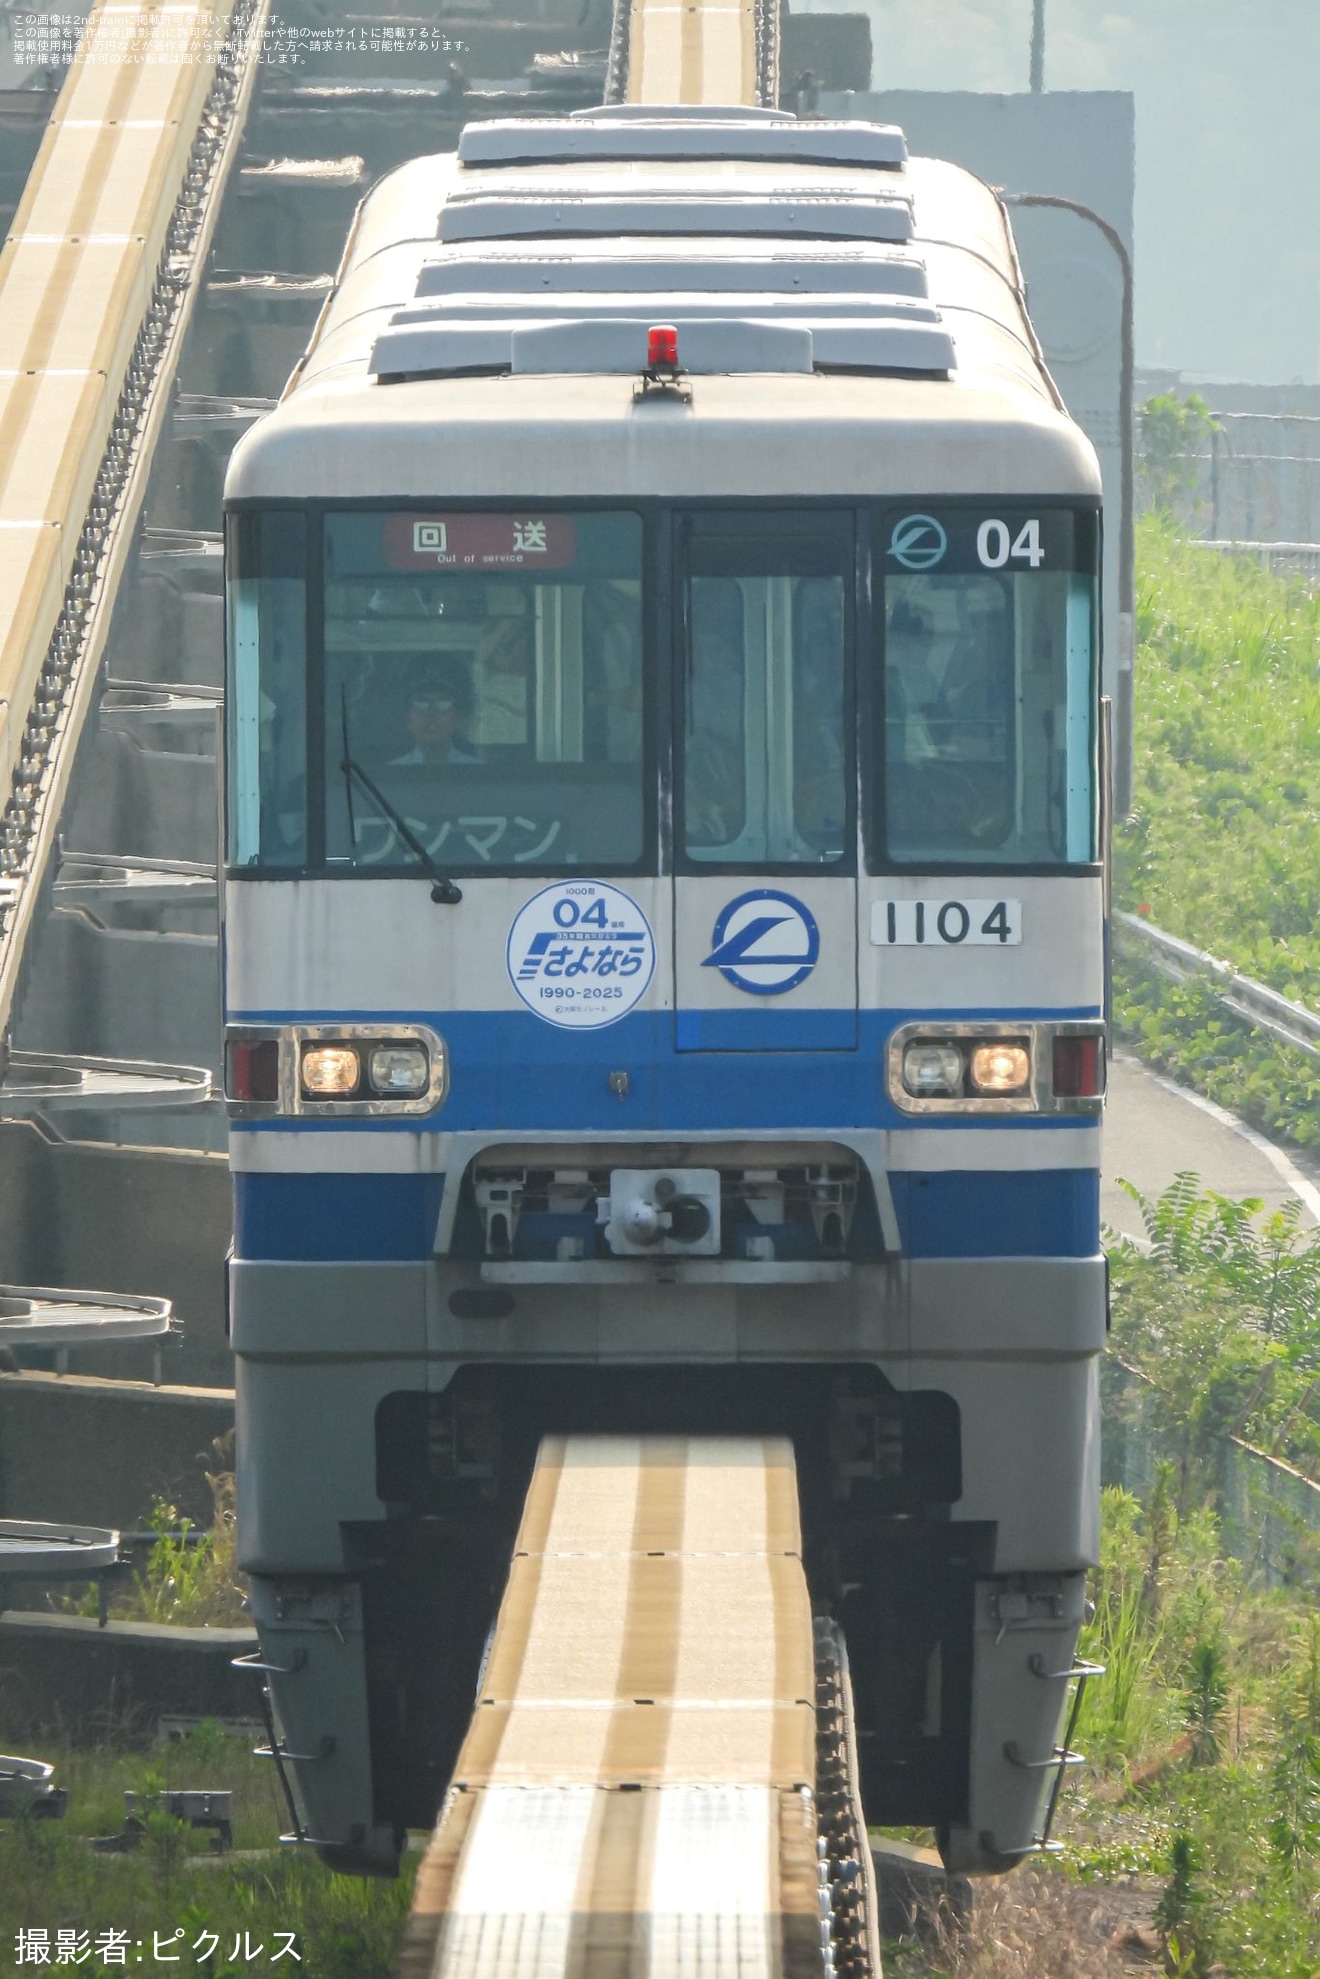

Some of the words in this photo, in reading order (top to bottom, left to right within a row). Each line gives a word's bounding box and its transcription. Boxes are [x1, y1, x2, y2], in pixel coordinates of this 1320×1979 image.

[438, 554, 456, 563] Out
[464, 554, 475, 563] of
[483, 554, 524, 563] service
[976, 519, 1045, 568] 04
[354, 816, 560, 863] ワンマン
[553, 898, 608, 928] 04
[887, 901, 1012, 944] 1104
[544, 945, 645, 977] さよなら
[540, 987, 623, 998] 1990-2025
